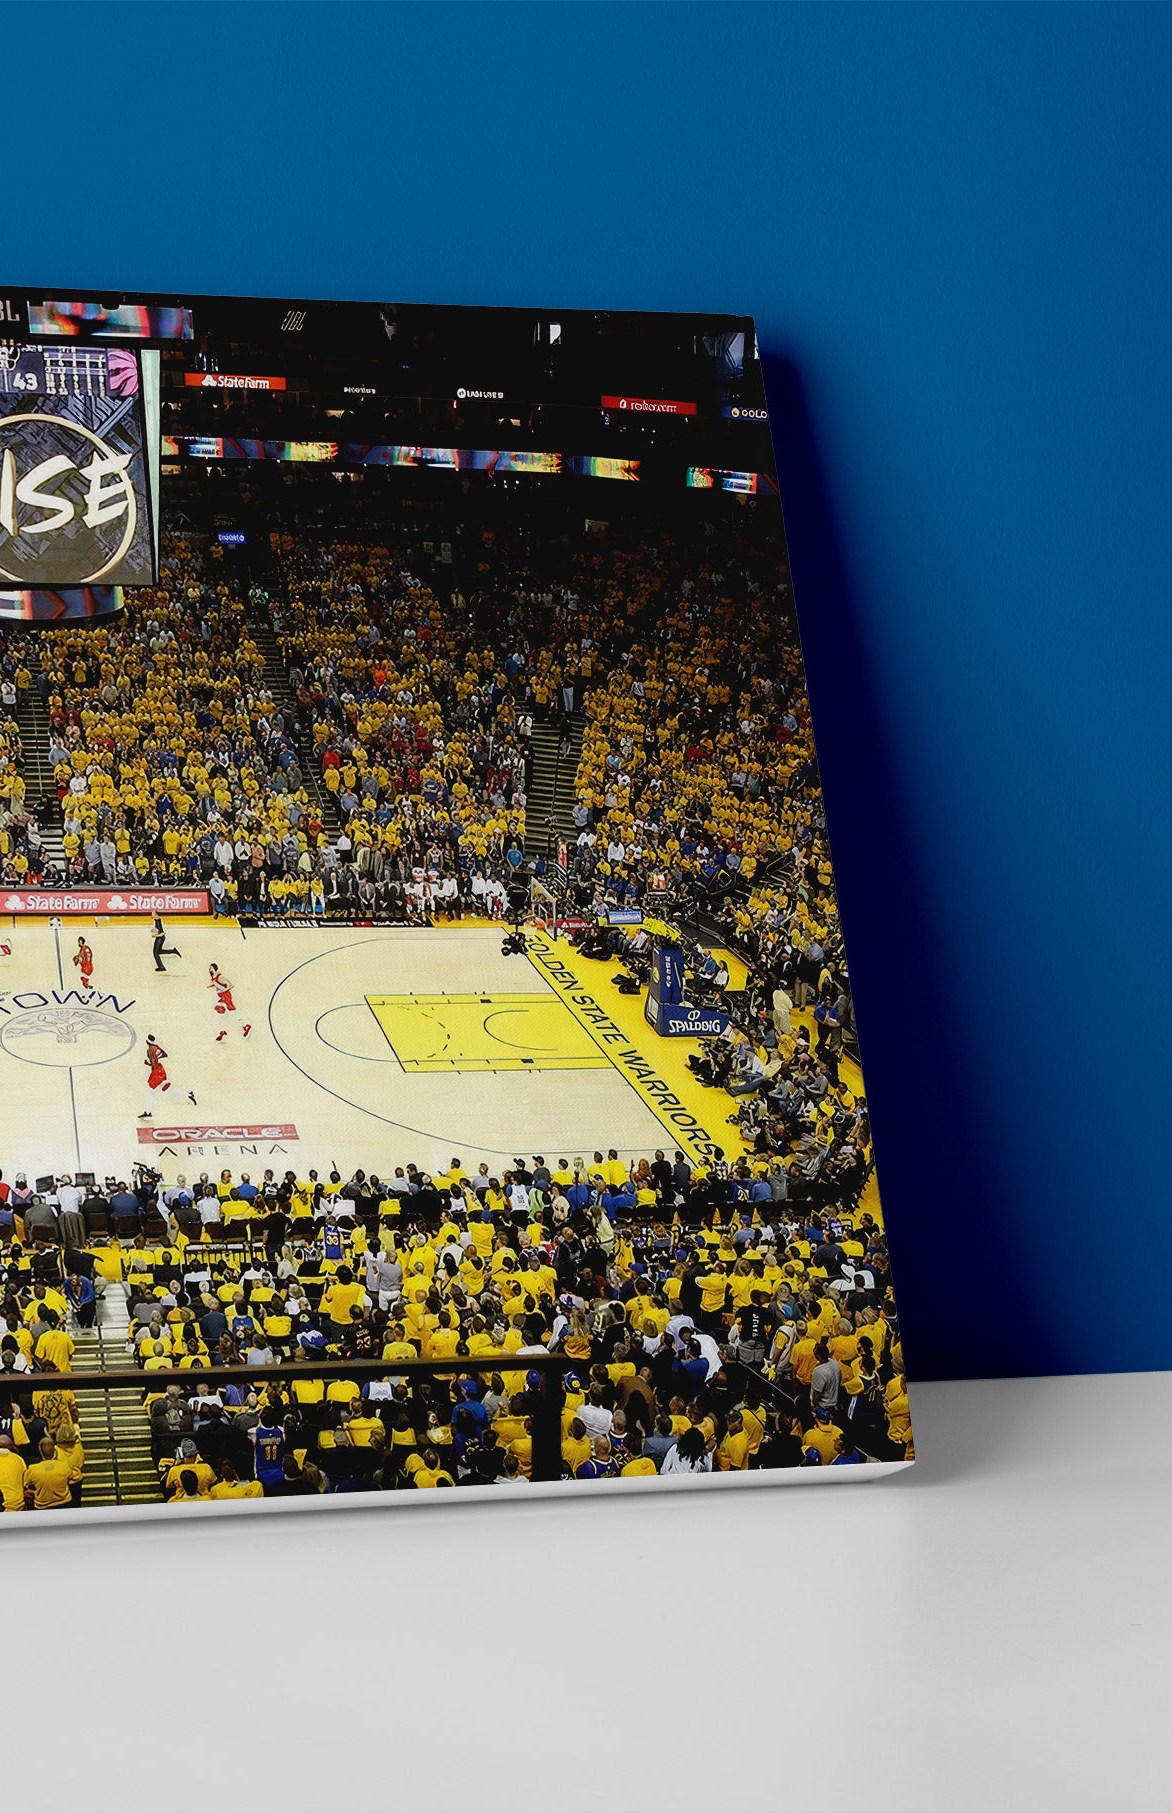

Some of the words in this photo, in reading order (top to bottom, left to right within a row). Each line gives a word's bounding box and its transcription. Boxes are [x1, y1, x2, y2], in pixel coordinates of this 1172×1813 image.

[12, 372, 38, 390] 43
[571, 994, 630, 1045] STATE
[617, 1049, 719, 1156] WARRIORS
[152, 1127, 283, 1141] ORACLE
